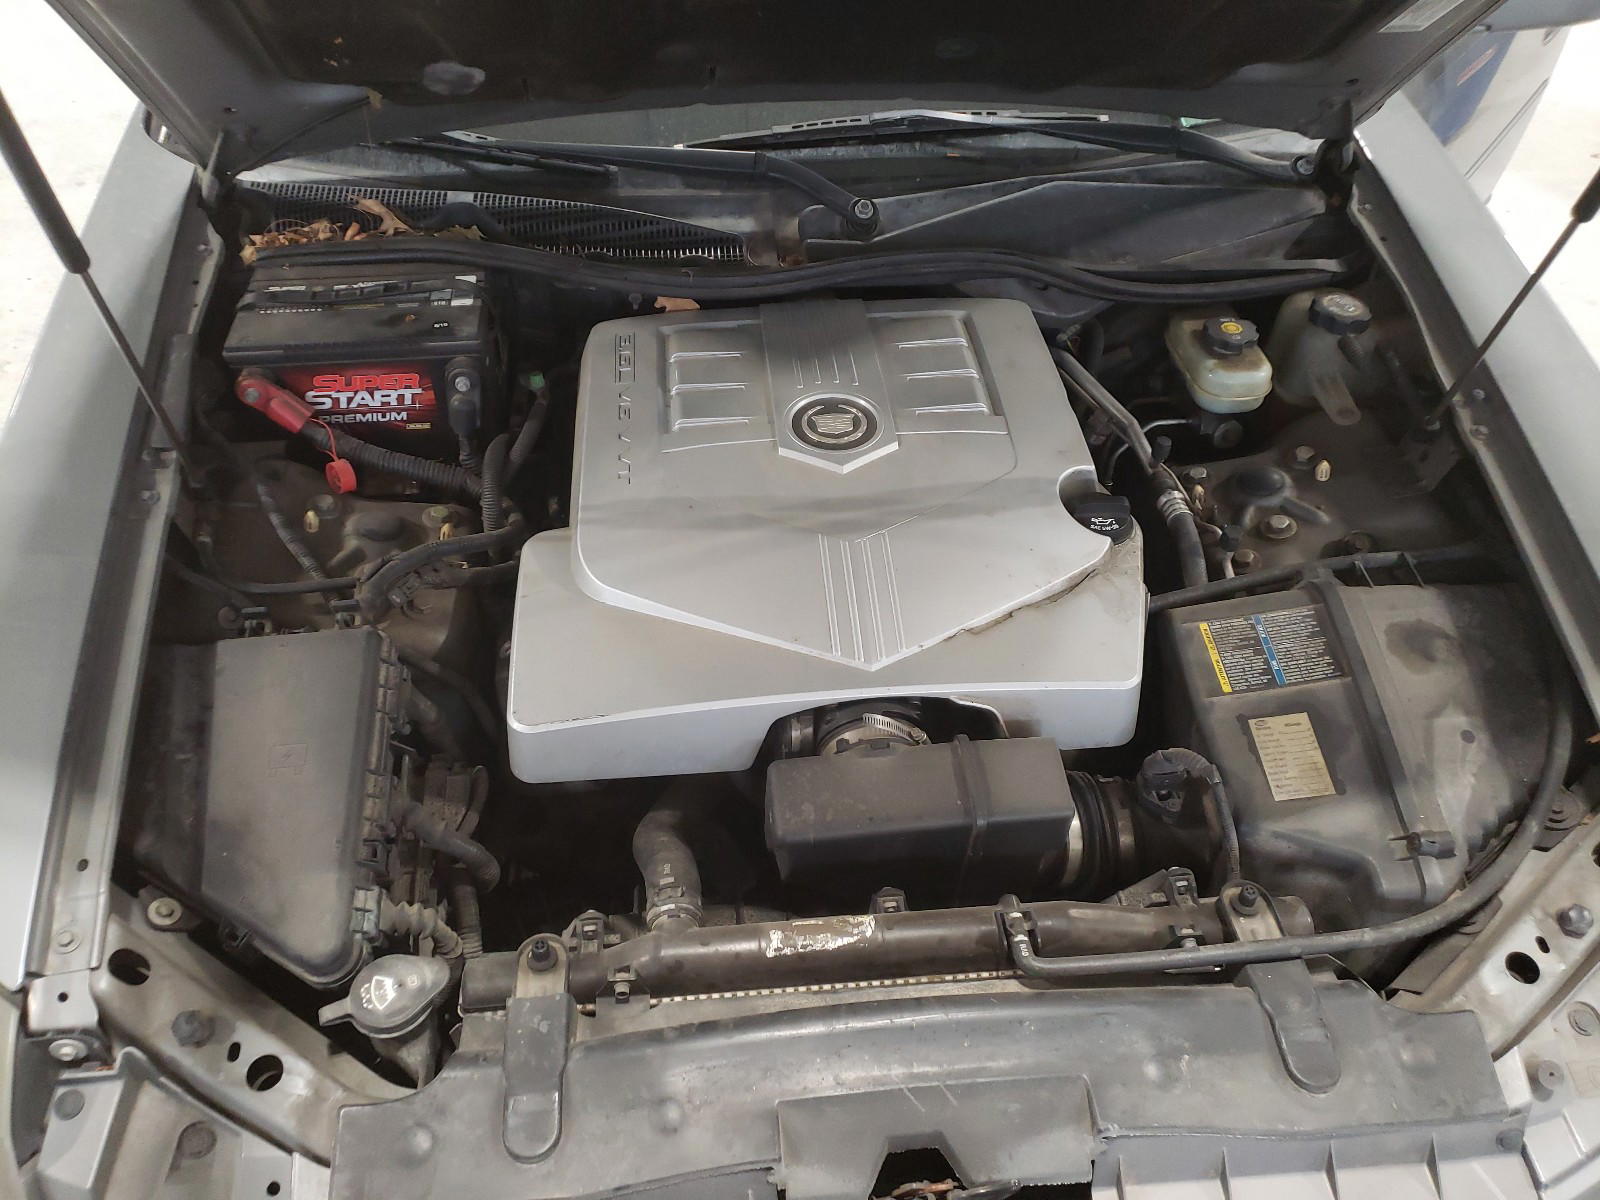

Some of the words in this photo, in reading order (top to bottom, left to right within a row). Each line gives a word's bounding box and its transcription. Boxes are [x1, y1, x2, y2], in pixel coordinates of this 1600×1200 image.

[312, 373, 421, 393] SUPER
[305, 388, 423, 410] START
[319, 411, 408, 424] PREMIUM
